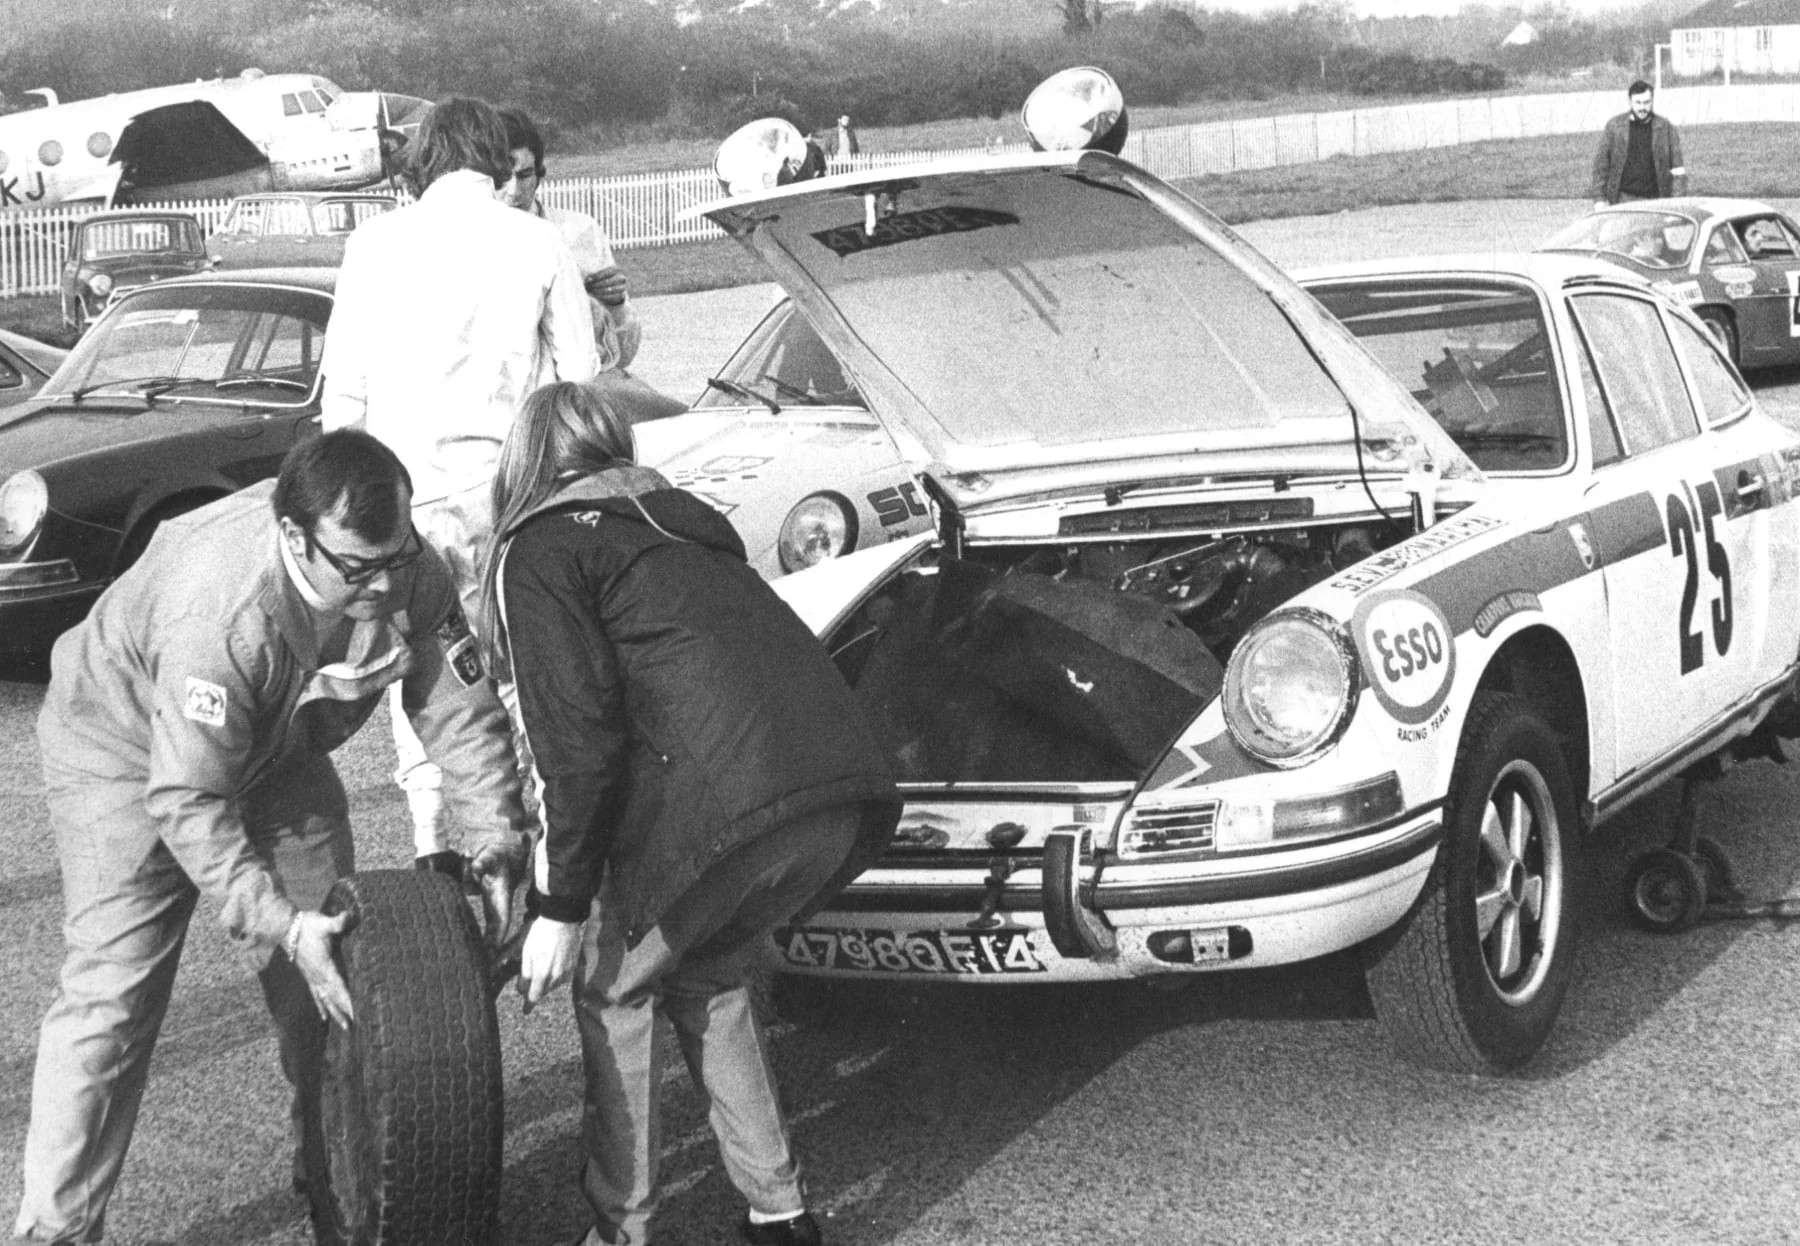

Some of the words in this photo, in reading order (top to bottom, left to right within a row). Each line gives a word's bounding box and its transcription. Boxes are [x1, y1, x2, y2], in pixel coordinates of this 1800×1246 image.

[1666, 480, 1733, 677] 25
[1398, 727, 1428, 743] RACING
[1430, 704, 1451, 732] TEAM
